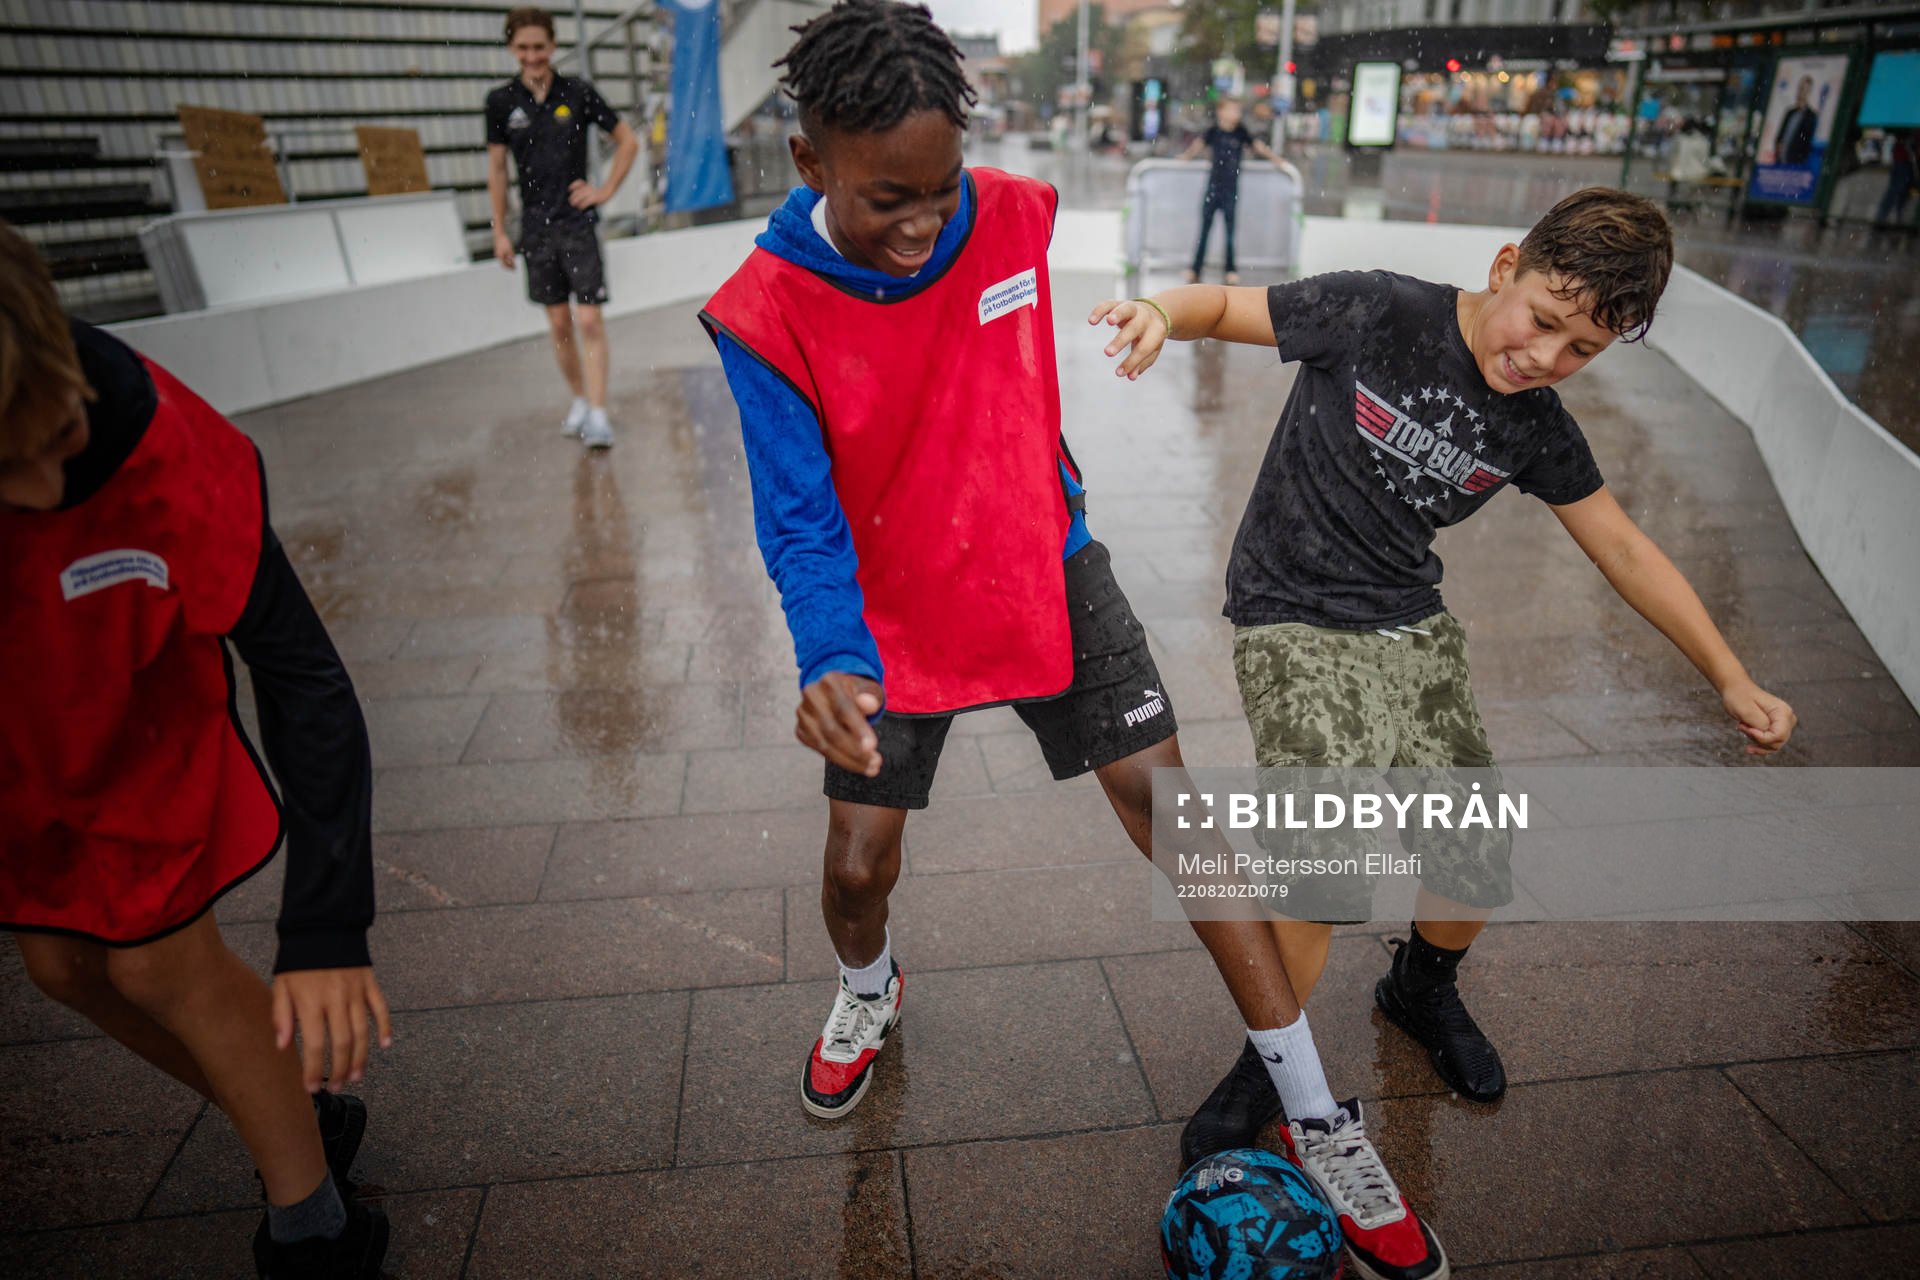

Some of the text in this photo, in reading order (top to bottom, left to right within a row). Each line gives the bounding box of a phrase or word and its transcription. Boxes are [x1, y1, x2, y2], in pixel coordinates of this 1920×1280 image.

[983, 303, 993, 316] på
[1384, 412, 1478, 487] TOP GUN
[1124, 698, 1164, 728] PUMA
